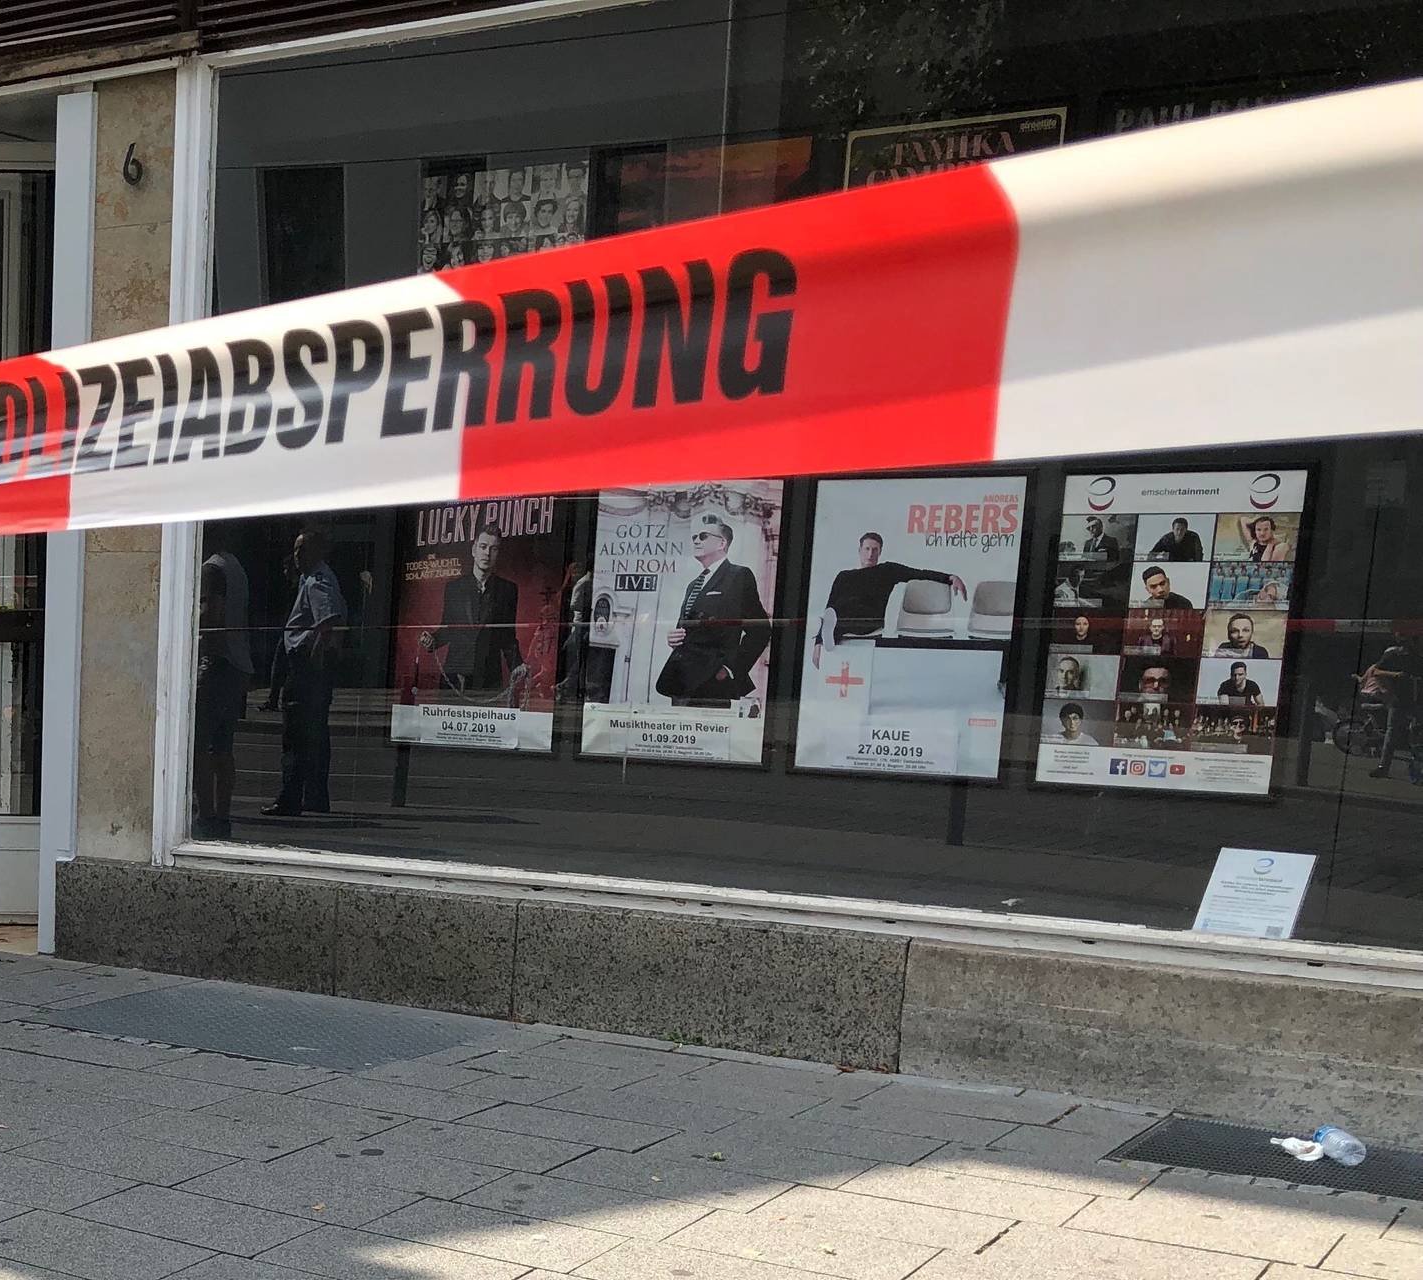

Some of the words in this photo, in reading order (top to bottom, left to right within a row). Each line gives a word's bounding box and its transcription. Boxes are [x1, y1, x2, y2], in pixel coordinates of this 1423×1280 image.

[122, 142, 143, 186] 6
[1140, 487, 1221, 497] emschertainment
[417, 504, 481, 547] LUCKY
[485, 495, 554, 538] PUNCH
[907, 504, 1018, 533] REBERS
[616, 521, 666, 539] GÖTZ
[599, 541, 683, 556] ALSMANN
[925, 531, 943, 547] ich
[981, 532, 1015, 553] gern
[635, 559, 676, 573] ROM
[616, 576, 657, 590] LIVE!
[422, 706, 517, 721] Ruhrfestspielhaus
[441, 721, 496, 734] 04.07.2019
[609, 719, 676, 732] Musiktheater
[679, 721, 693, 731] im
[695, 723, 730, 734] Revier
[642, 733, 696, 745] 01.09.2019
[872, 729, 911, 742] KAUE
[858, 744, 924, 757] 27.09.2019
